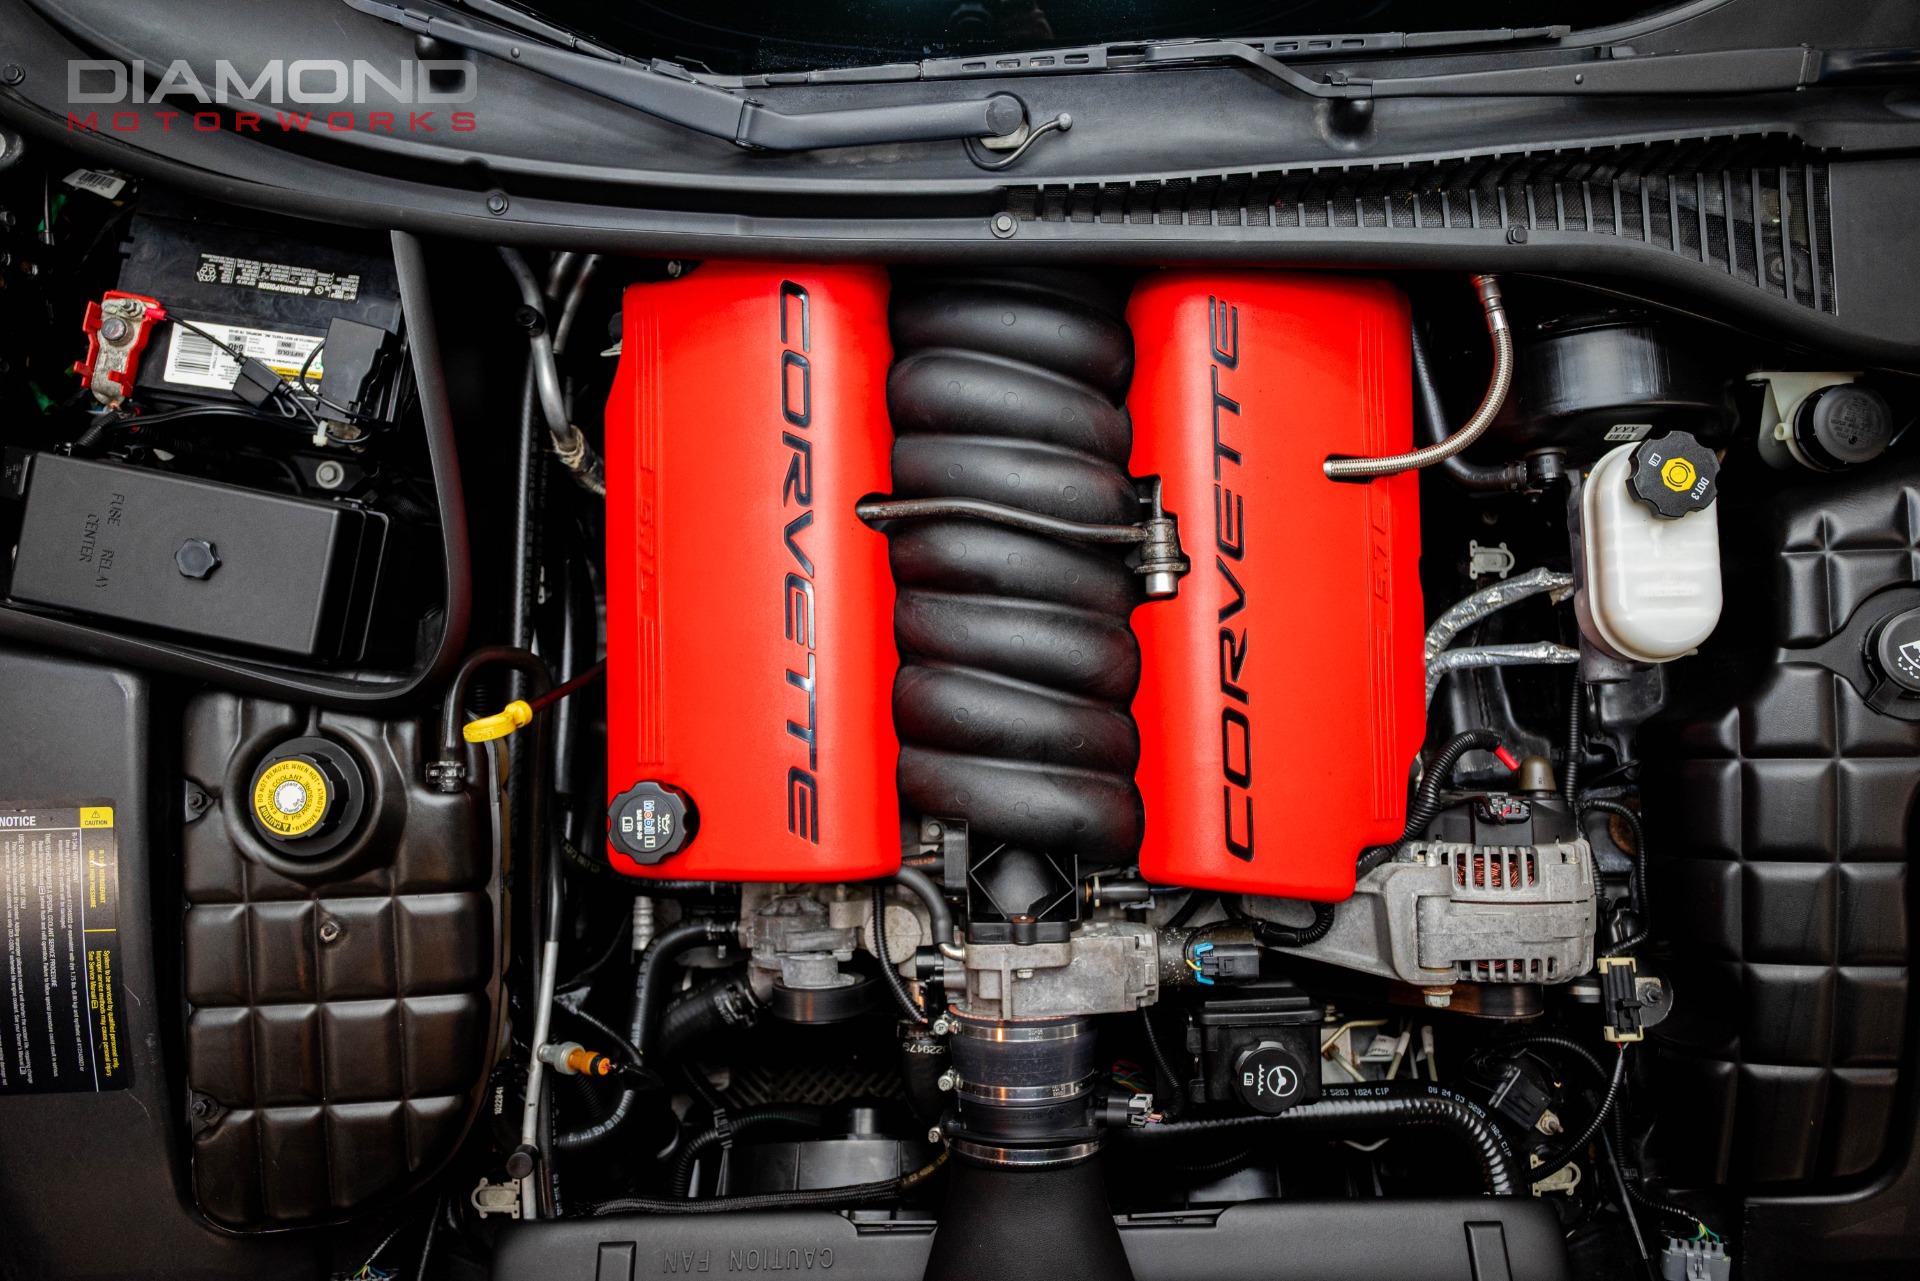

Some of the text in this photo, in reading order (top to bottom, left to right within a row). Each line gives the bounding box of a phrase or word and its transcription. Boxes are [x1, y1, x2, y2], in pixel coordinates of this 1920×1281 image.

[228, 343, 244, 351] 640
[1691, 477, 1709, 500] DOT 3
[79, 513, 100, 562] CENTER
[95, 493, 124, 591] FUSE RELAY
[780, 279, 818, 846] CORVETTE
[1373, 505, 1388, 604] 5.7L
[1209, 295, 1253, 861] CORVETTE
[258, 794, 263, 803] DO
[266, 764, 289, 780] REMOVE
[292, 764, 309, 772] WHEN
[309, 771, 319, 783] HOT
[267, 789, 276, 815] ENGINE
[273, 774, 302, 787] COOLANT
[302, 782, 313, 814] PRESSURE
[0, 816, 36, 827] NOTICE
[644, 800, 655, 835] Mobil
[102, 1042, 110, 1062] personal
[110, 1034, 118, 1057] personnel
[1441, 1089, 1451, 1098] 24
[1455, 1094, 1465, 1103] 03
[662, 1247, 834, 1274] CAUTION FAN
